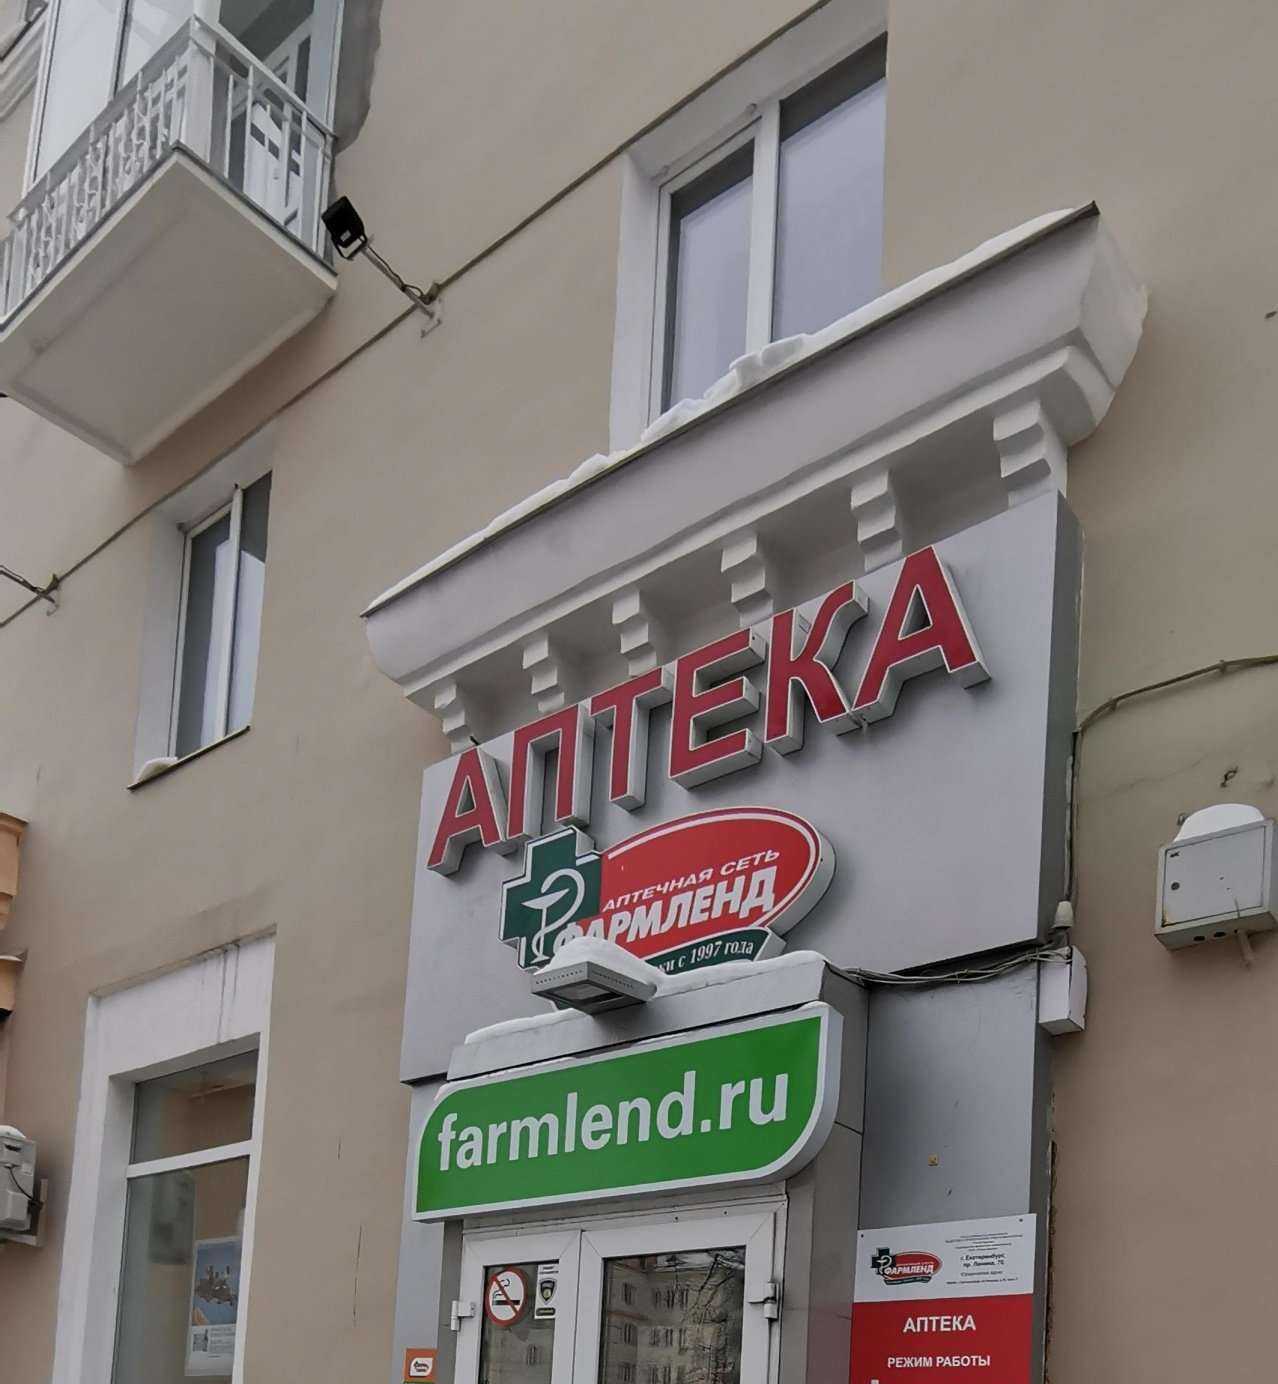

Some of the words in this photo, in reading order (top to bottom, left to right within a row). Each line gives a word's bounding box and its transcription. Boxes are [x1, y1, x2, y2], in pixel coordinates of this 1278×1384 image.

[427, 545, 980, 870] АПТЕКА
[602, 870, 712, 913] АПТЕЧНАЯ
[720, 849, 780, 877] СЕТЬ
[553, 865, 777, 949] ФАРМЛЕНД
[690, 940, 722, 964] 1997
[724, 940, 754, 955] года
[438, 1070, 789, 1171] farmlend.ru
[884, 1263, 934, 1275] ФАРМЛЕНД
[903, 1315, 976, 1333] АПТЕКА
[887, 1357, 933, 1368] РЕЖИМ
[936, 1355, 991, 1367] РАБОТЫ
